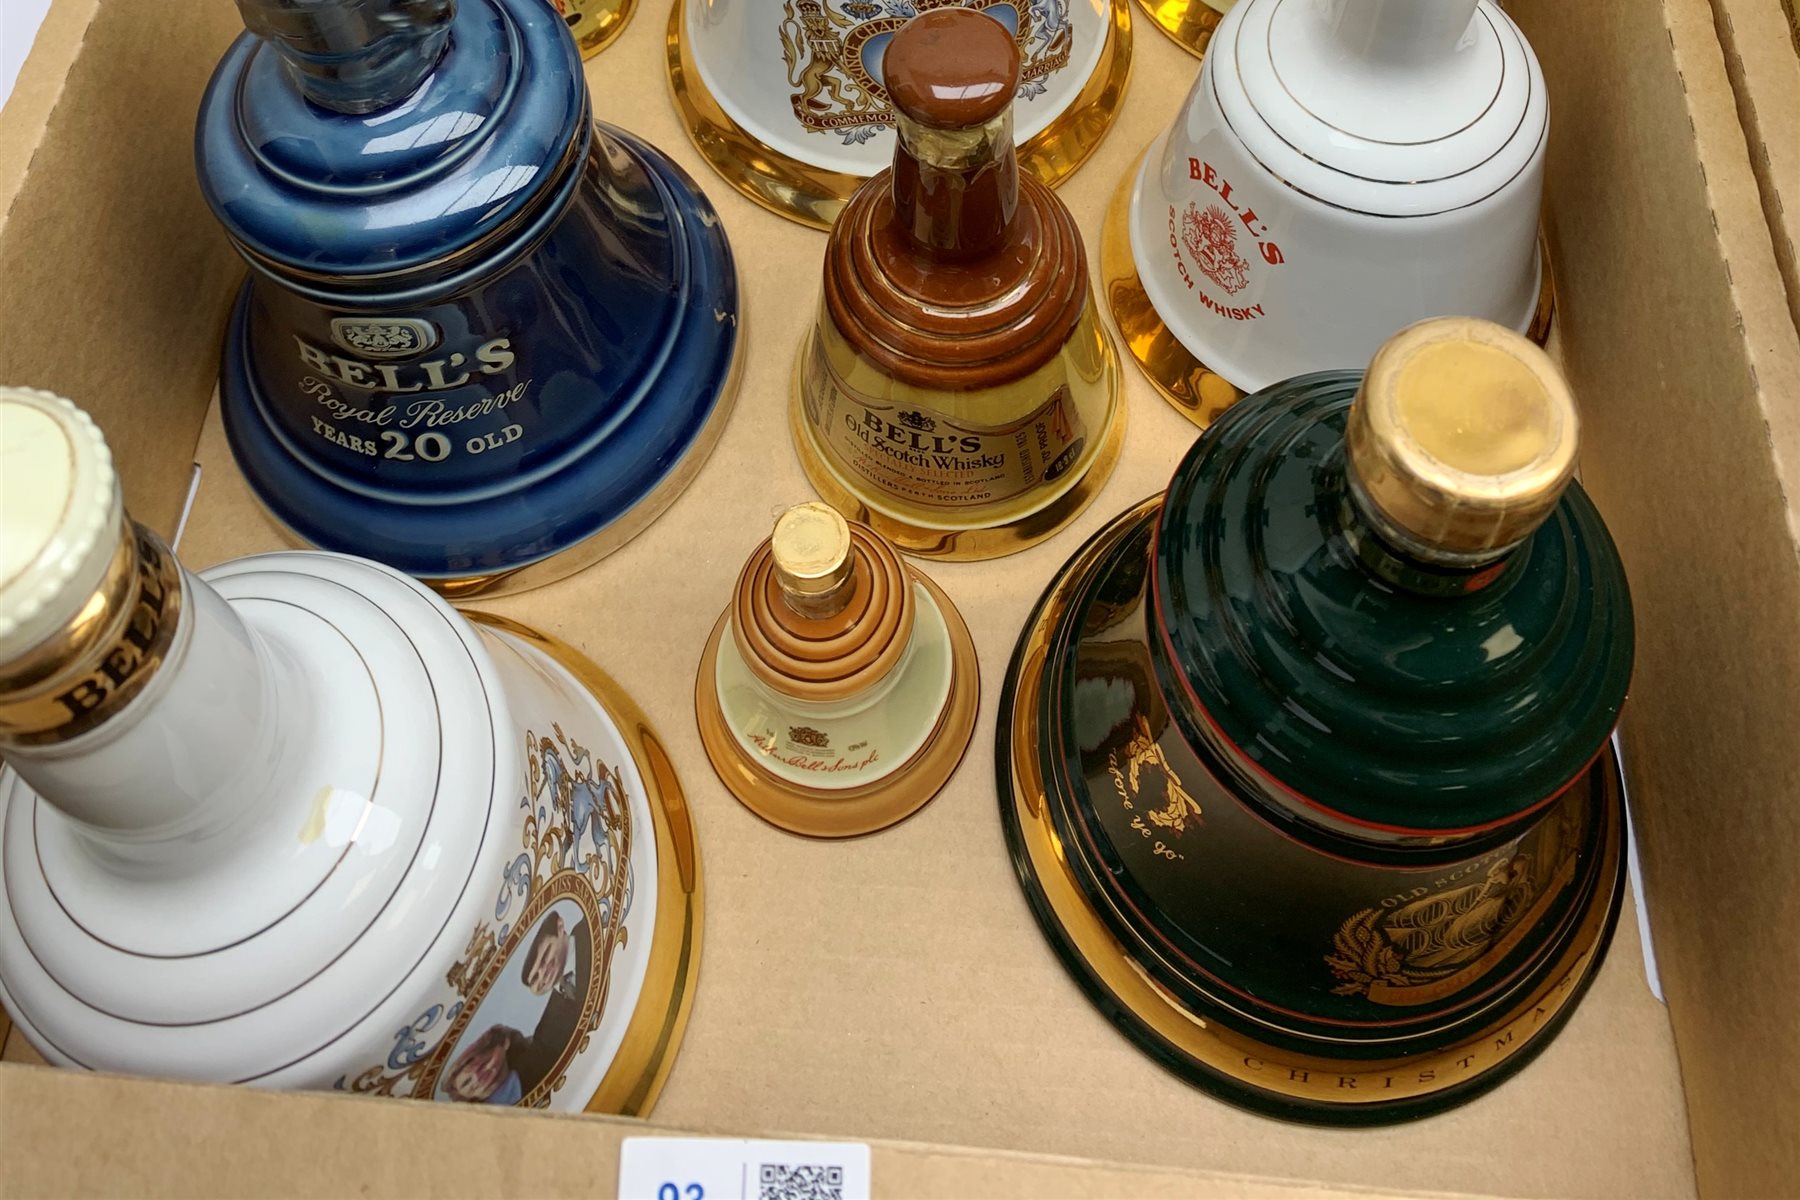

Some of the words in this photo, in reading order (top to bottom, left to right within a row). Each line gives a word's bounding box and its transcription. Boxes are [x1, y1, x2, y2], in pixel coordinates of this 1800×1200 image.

[854, 19, 905, 40] CHAR
[844, 42, 874, 91] PRINCE
[800, 111, 815, 126] TO
[821, 113, 897, 128] COMMEMOR
[1188, 157, 1285, 266] BELL'S
[1168, 204, 1194, 290] SCOTCH
[1199, 290, 1266, 321] WHISKY
[293, 334, 515, 392] BELL'S
[298, 376, 397, 426] Royal
[399, 378, 533, 429] Reserve
[311, 415, 378, 457] YEARS
[381, 431, 452, 462] 20
[466, 423, 524, 455] OLD
[845, 414, 869, 443] Old
[872, 436, 930, 468] Scotch
[931, 453, 1005, 471] Whisky
[863, 408, 981, 454] BELL'S
[852, 459, 899, 490] DISTILLERS
[901, 487, 934, 499] PERTH
[936, 492, 992, 501] SCOTLAND
[875, 460, 906, 477] BLENDED
[916, 477, 950, 486] BOTTLED
[964, 473, 1006, 486] SCOTLAND
[920, 467, 975, 479] SELECTED
[1131, 814, 1152, 838] ye
[514, 894, 546, 939] WITH
[550, 876, 573, 899] MISS
[1381, 887, 1428, 908] OLD
[1244, 975, 1572, 1089] CHRISTMAS
